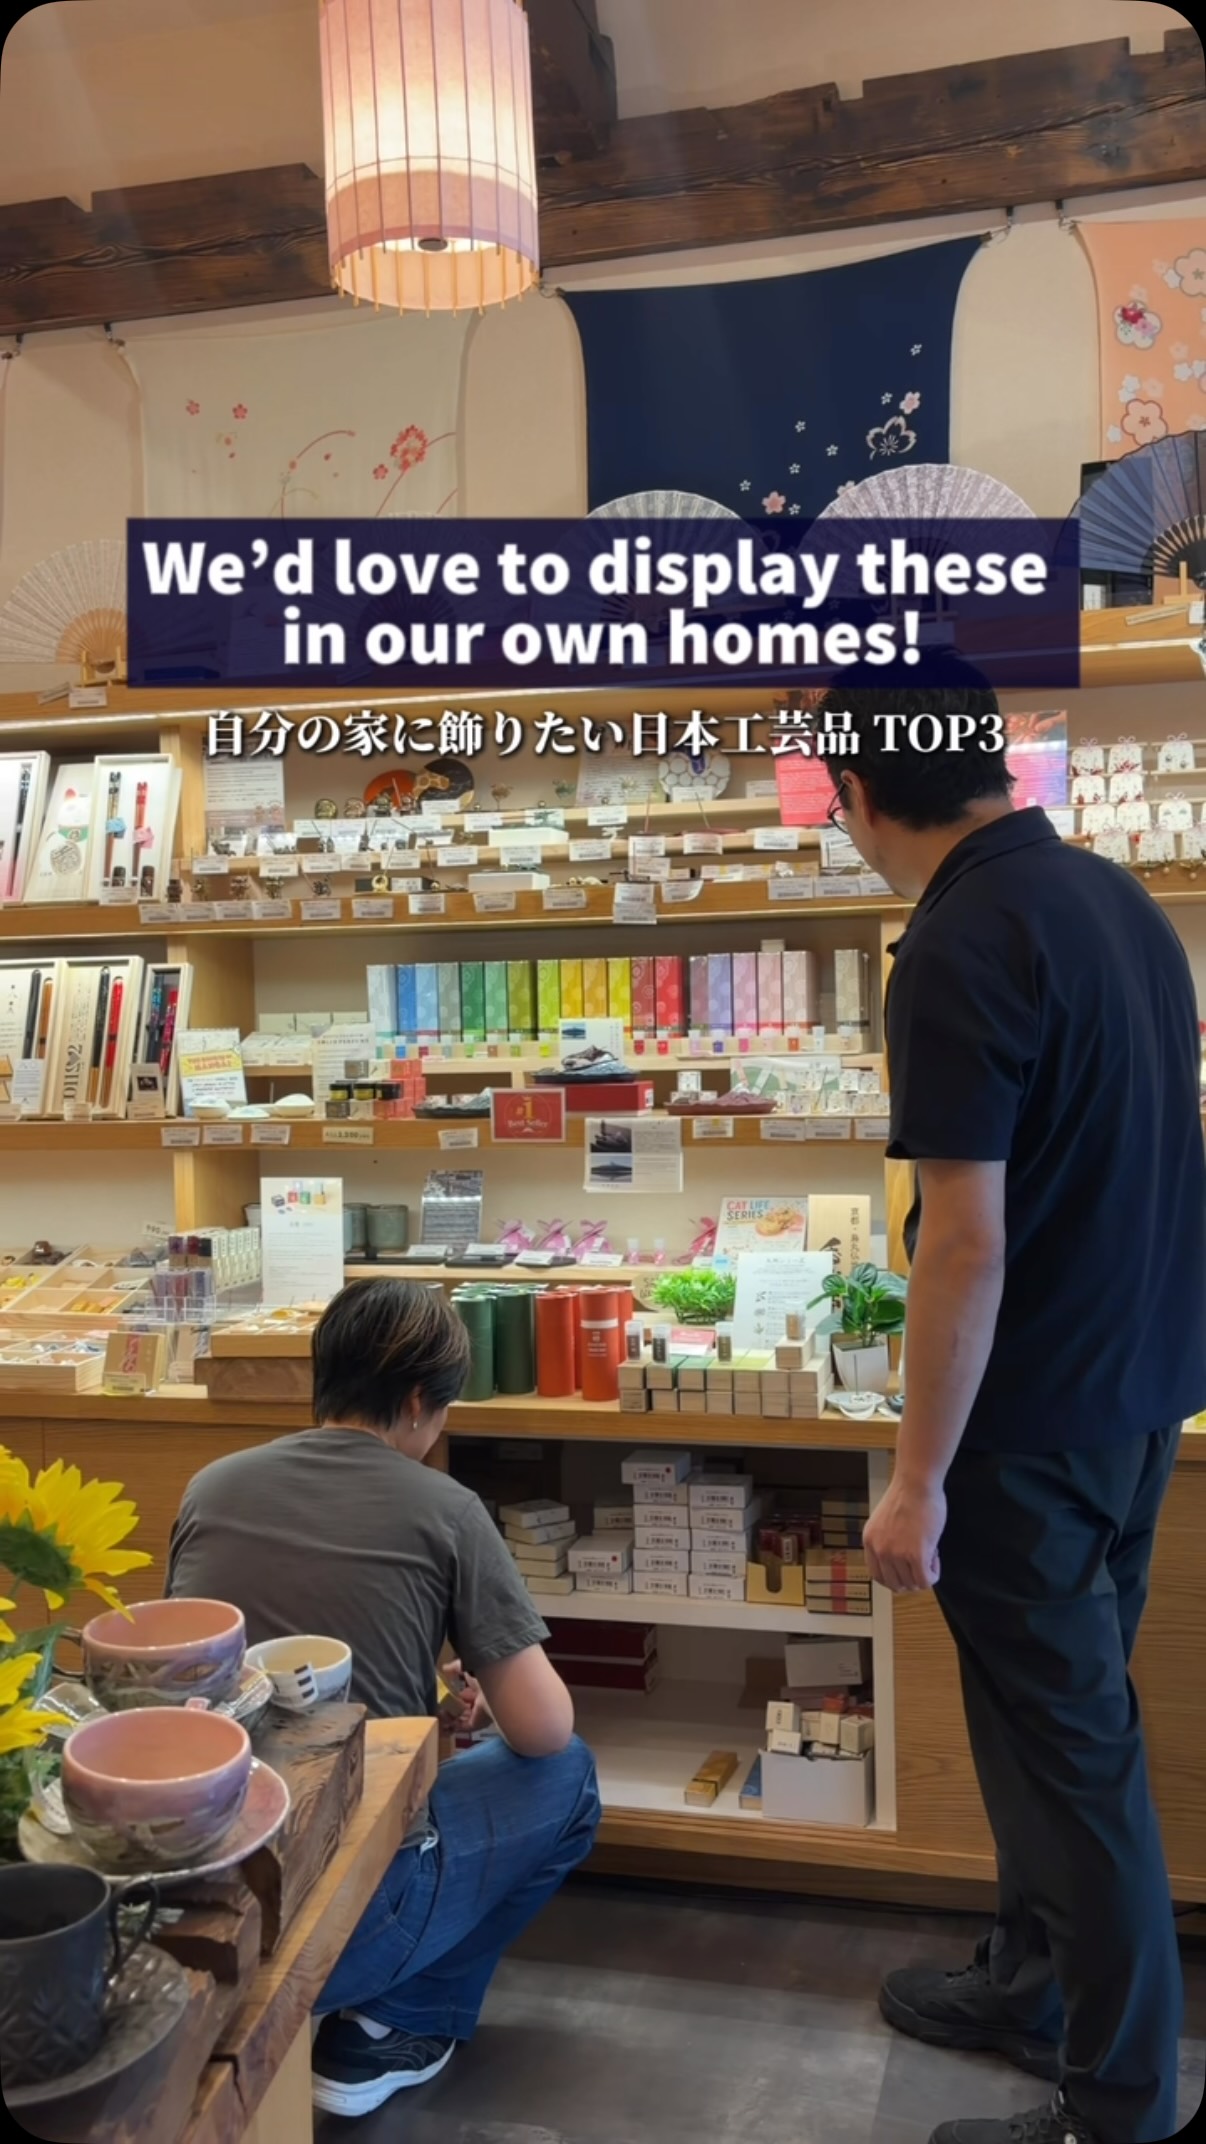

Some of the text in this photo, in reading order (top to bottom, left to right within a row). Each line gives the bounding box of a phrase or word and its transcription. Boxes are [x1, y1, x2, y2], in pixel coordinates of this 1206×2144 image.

[507, 1119, 549, 1128] Best Seller
[726, 1199, 770, 1211] CAT LIFE
[726, 1209, 764, 1221] SERIES
